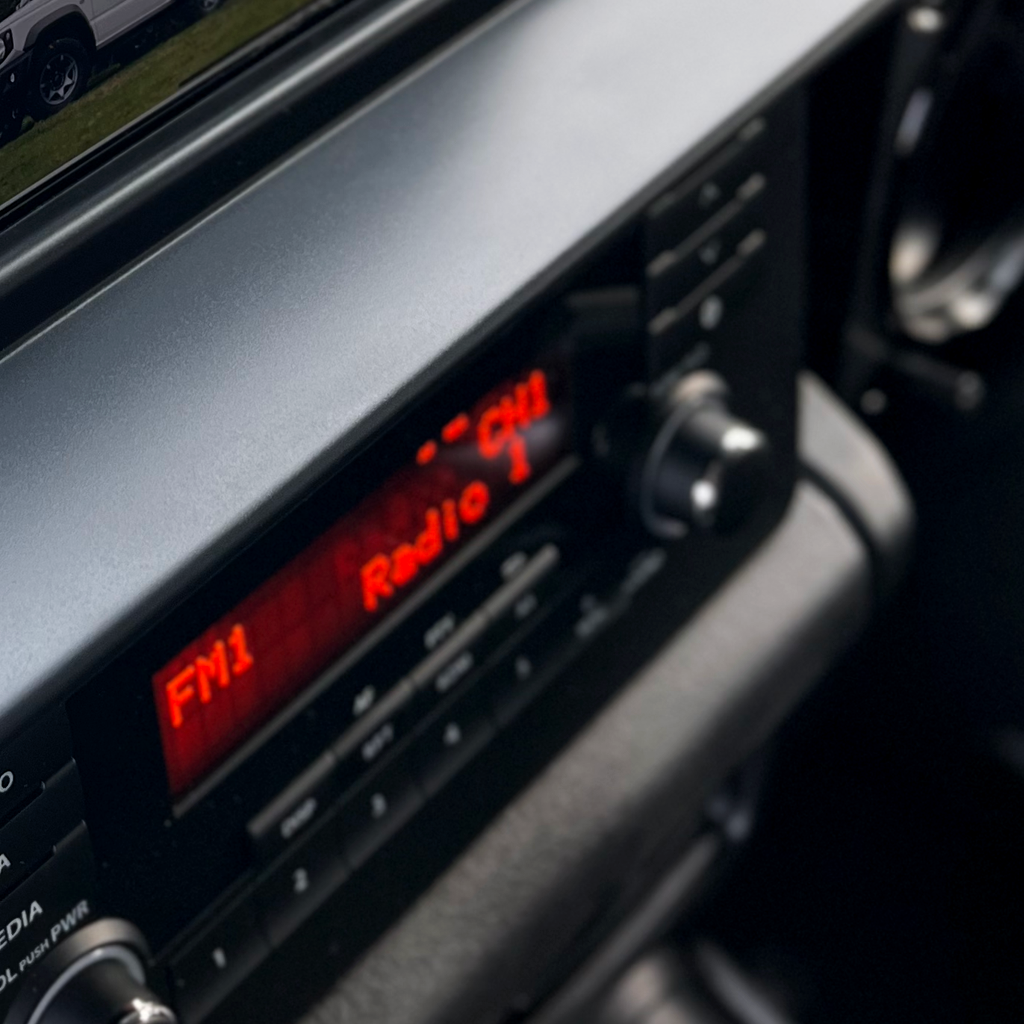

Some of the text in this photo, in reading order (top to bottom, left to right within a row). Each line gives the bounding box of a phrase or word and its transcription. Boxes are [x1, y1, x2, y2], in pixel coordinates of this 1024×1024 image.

[360, 481, 490, 611] Radio
[166, 623, 254, 728] FM1
[18, 938, 50, 972] PUSH
[50, 899, 90, 943] PWR
